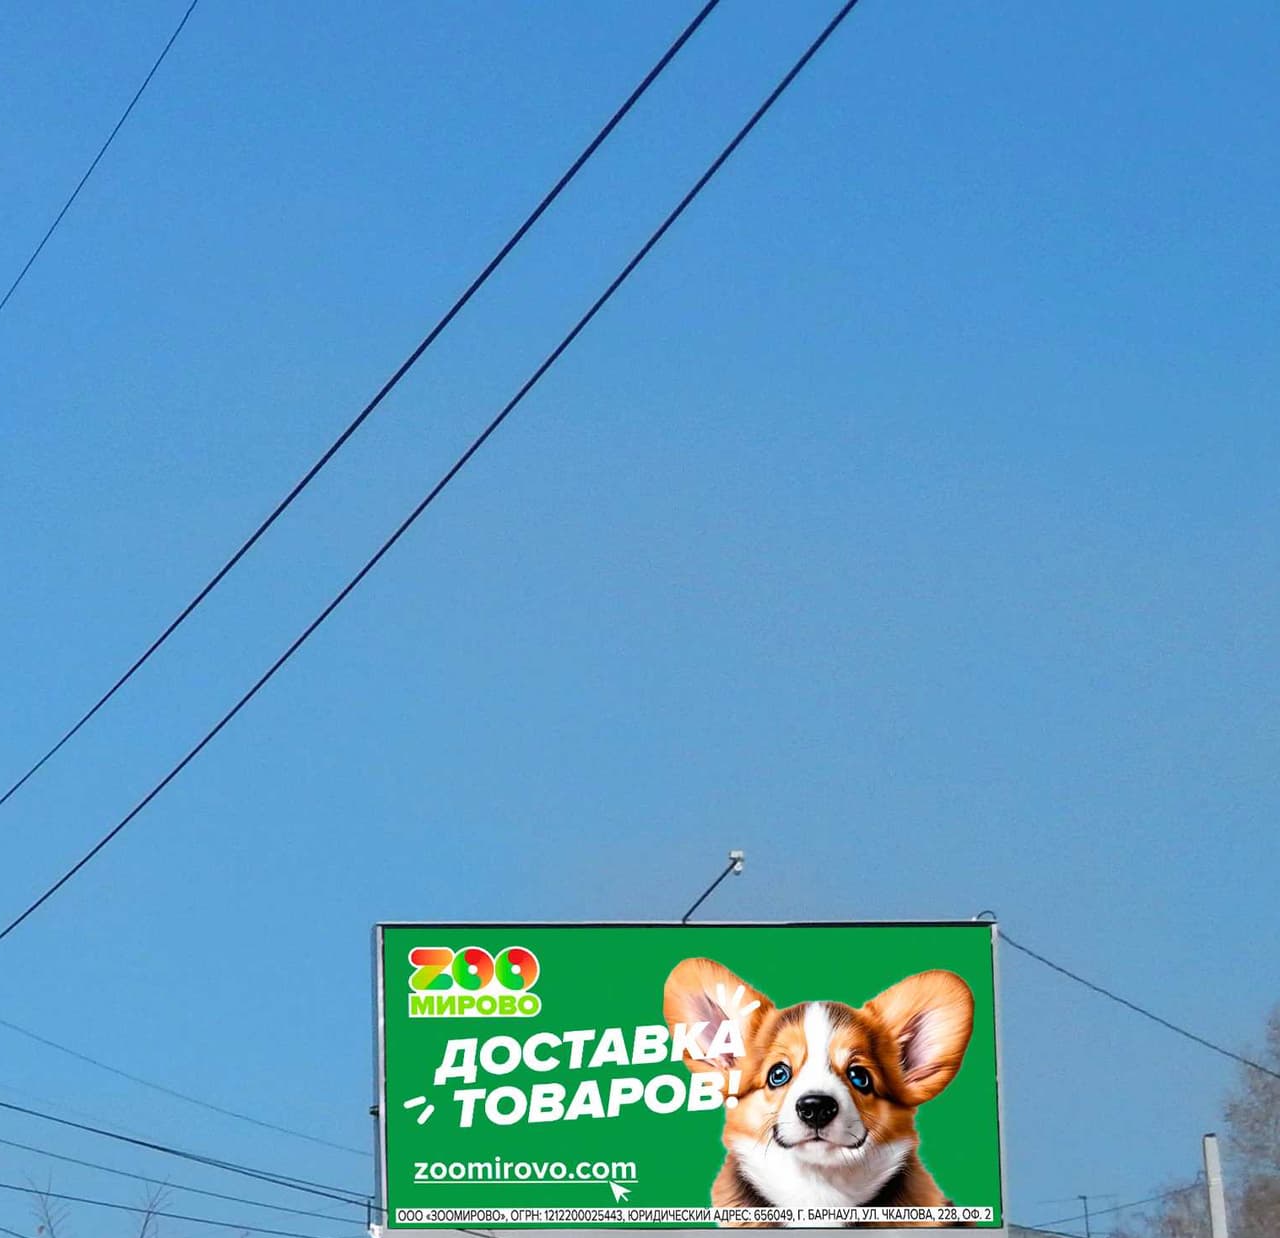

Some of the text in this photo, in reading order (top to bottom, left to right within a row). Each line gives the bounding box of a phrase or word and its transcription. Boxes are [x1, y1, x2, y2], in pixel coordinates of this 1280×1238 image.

[410, 947, 539, 992] ZOO
[410, 994, 539, 1016] МИРОВО
[433, 1019, 746, 1086] ДОСТАВКА
[452, 1069, 742, 1128] ТОВАРОВ!
[413, 1156, 637, 1180] zoomirovo.com
[397, 1209, 424, 1222] ООО
[426, 1209, 509, 1223] «ЗООМИРОВО»,
[510, 1209, 543, 1222] ОГРН:
[544, 1209, 626, 1223] 1212200025443,
[627, 1207, 710, 1223] ЮРИДИЧЕСКИЙ
[713, 1209, 752, 1222] АДРЕС:
[753, 1208, 796, 1222] 656049,
[807, 1208, 861, 1222] БАРНАУЛ,
[862, 1208, 880, 1221] УЛ.
[881, 1208, 936, 1222] ЧКАЛОВА,
[937, 1208, 960, 1222] 228,
[962, 1208, 983, 1221] ОФ.
[984, 1208, 992, 1220] 2
